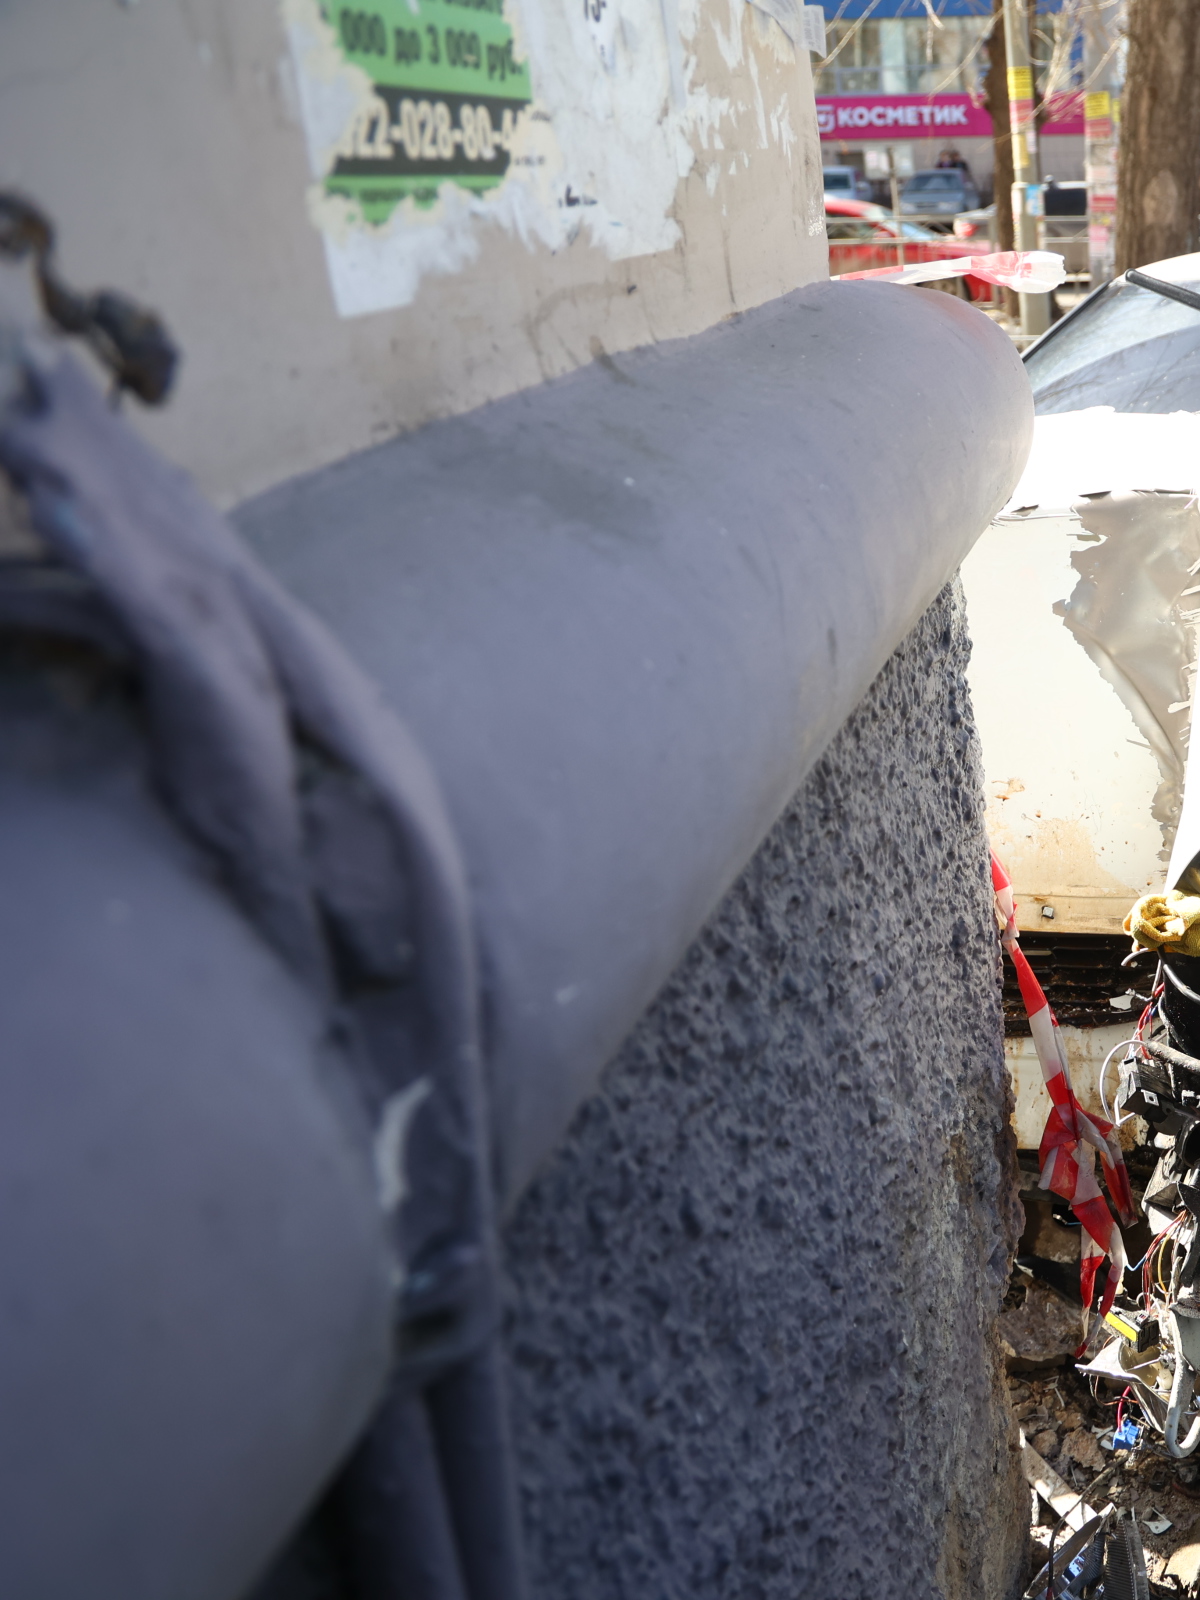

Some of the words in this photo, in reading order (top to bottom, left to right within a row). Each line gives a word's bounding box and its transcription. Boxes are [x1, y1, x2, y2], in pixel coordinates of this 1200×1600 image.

[394, 26, 421, 66] до
[426, 23, 441, 65] 3
[837, 104, 968, 127] КОСМЕТИК
